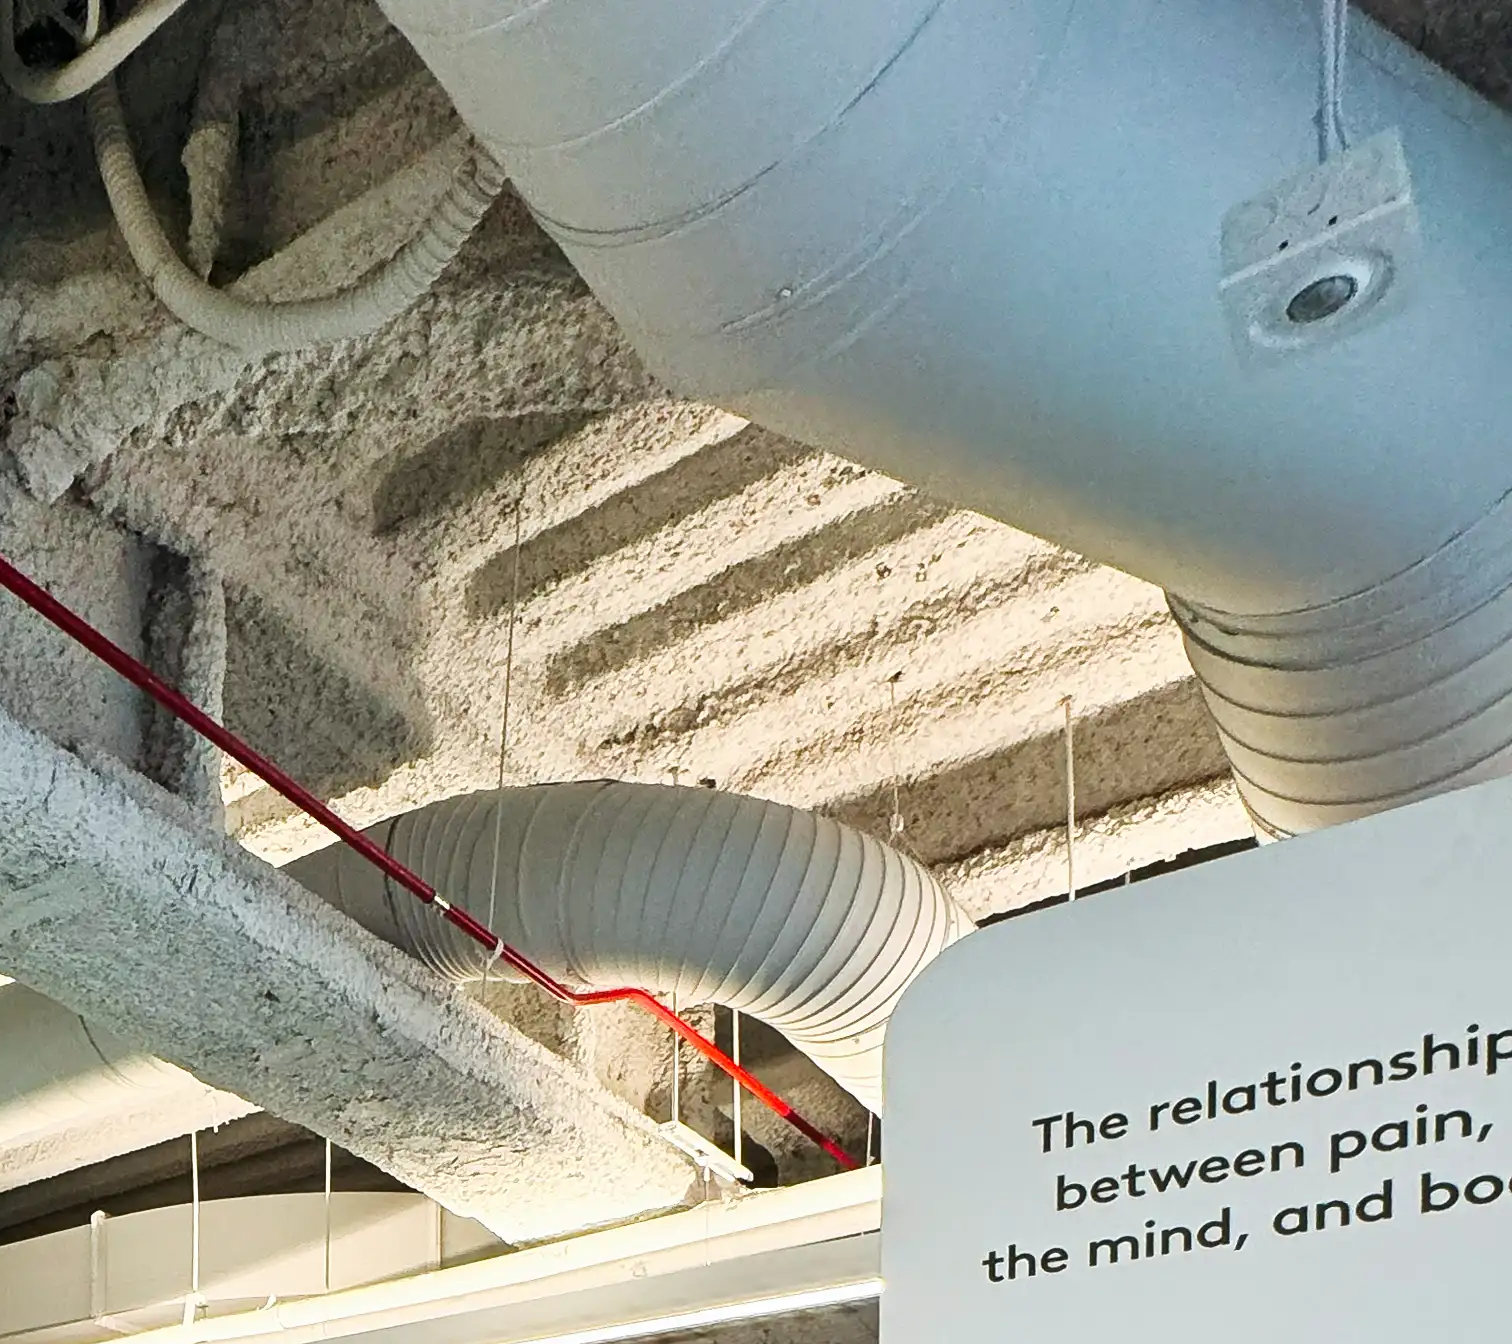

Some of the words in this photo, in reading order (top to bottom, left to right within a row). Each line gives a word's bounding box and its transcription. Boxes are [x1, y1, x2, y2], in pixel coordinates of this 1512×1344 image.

[1032, 1111, 1129, 1153] The
[1150, 1025, 1512, 1131] relationship
[1057, 1142, 1304, 1211] between
[1330, 1107, 1493, 1174] pain,
[982, 1244, 1068, 1283] the
[1089, 1207, 1249, 1267] mind,
[1273, 1179, 1393, 1236] and
[1421, 1171, 1512, 1215] bo
